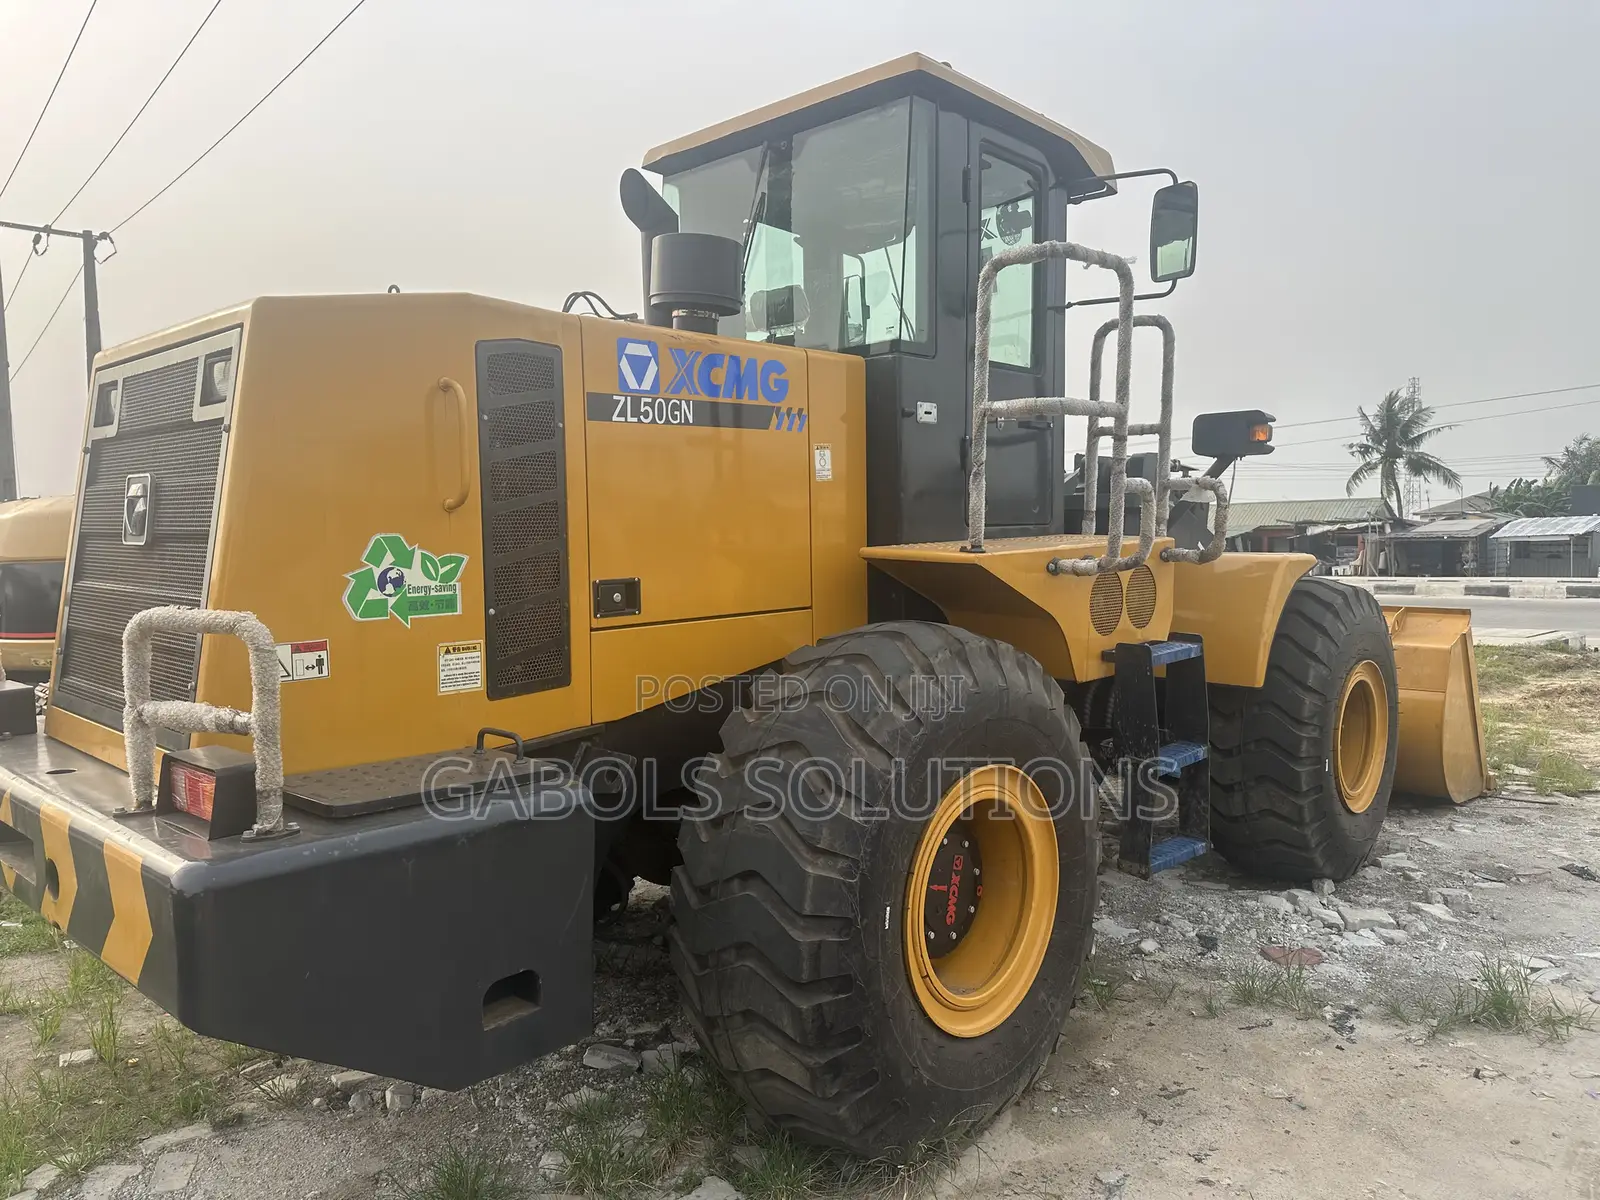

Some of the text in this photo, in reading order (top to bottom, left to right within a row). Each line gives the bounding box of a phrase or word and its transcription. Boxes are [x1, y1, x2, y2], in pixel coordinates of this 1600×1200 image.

[664, 347, 790, 403] XCMG
[611, 395, 694, 424] ZL50GN
[407, 583, 457, 596] Energy-saving
[946, 871, 961, 926] XCMG
